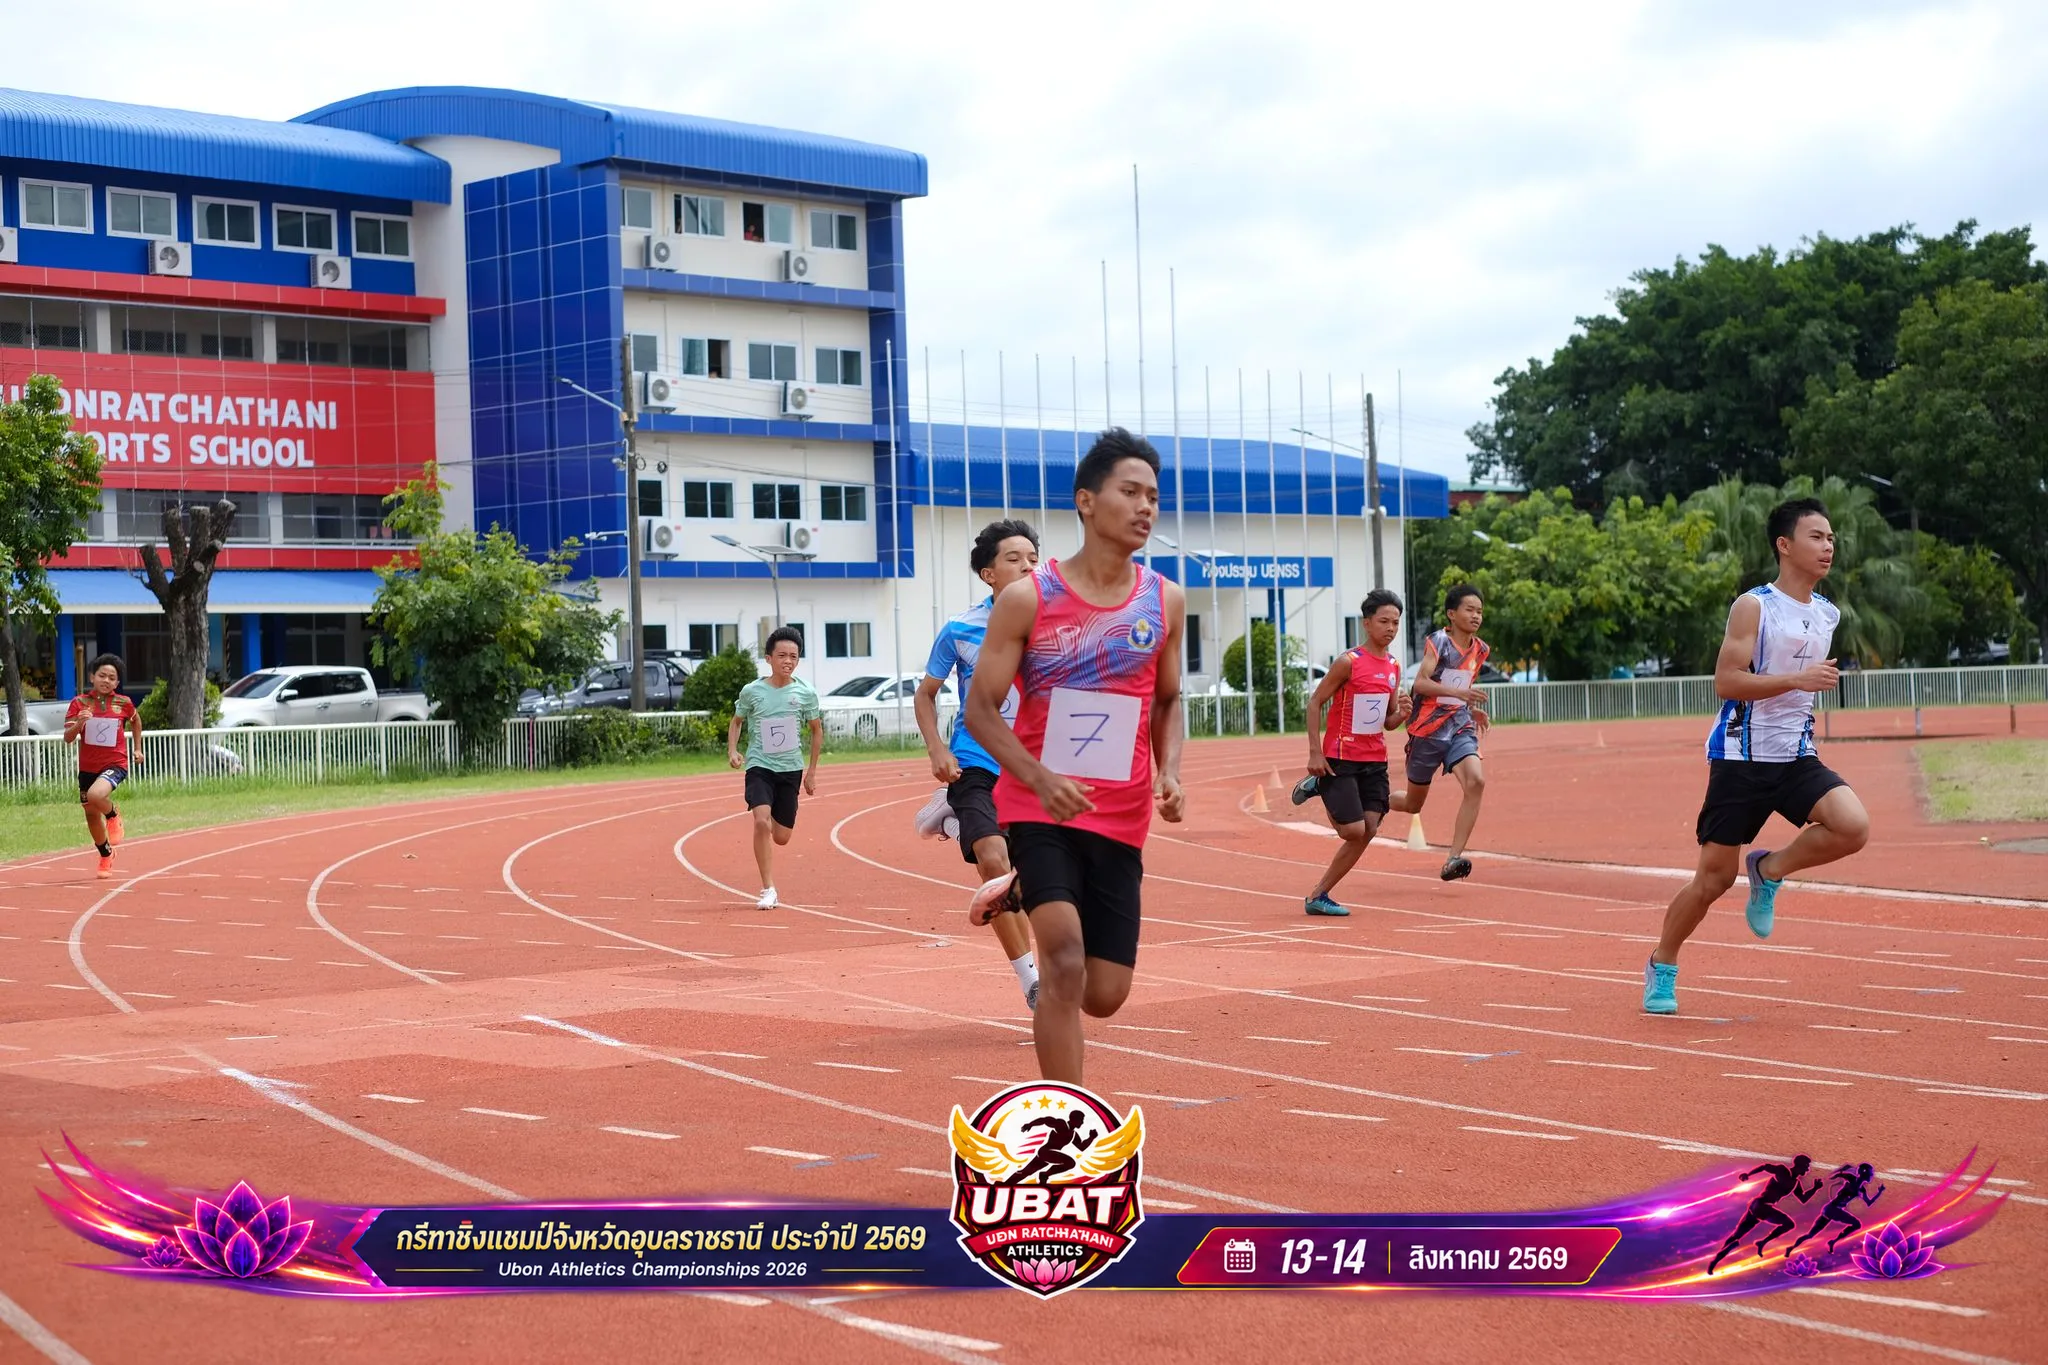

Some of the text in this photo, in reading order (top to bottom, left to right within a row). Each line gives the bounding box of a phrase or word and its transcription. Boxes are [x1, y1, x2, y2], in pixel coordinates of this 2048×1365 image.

[0, 384, 337, 430] ONRATCHATHANI
[189, 434, 315, 468] SCHOOL
[1792, 640, 1813, 671] 4
[1363, 699, 1382, 725] 3
[95, 720, 110, 743] 8
[770, 725, 786, 747] 5
[1069, 713, 1110, 758] 7
